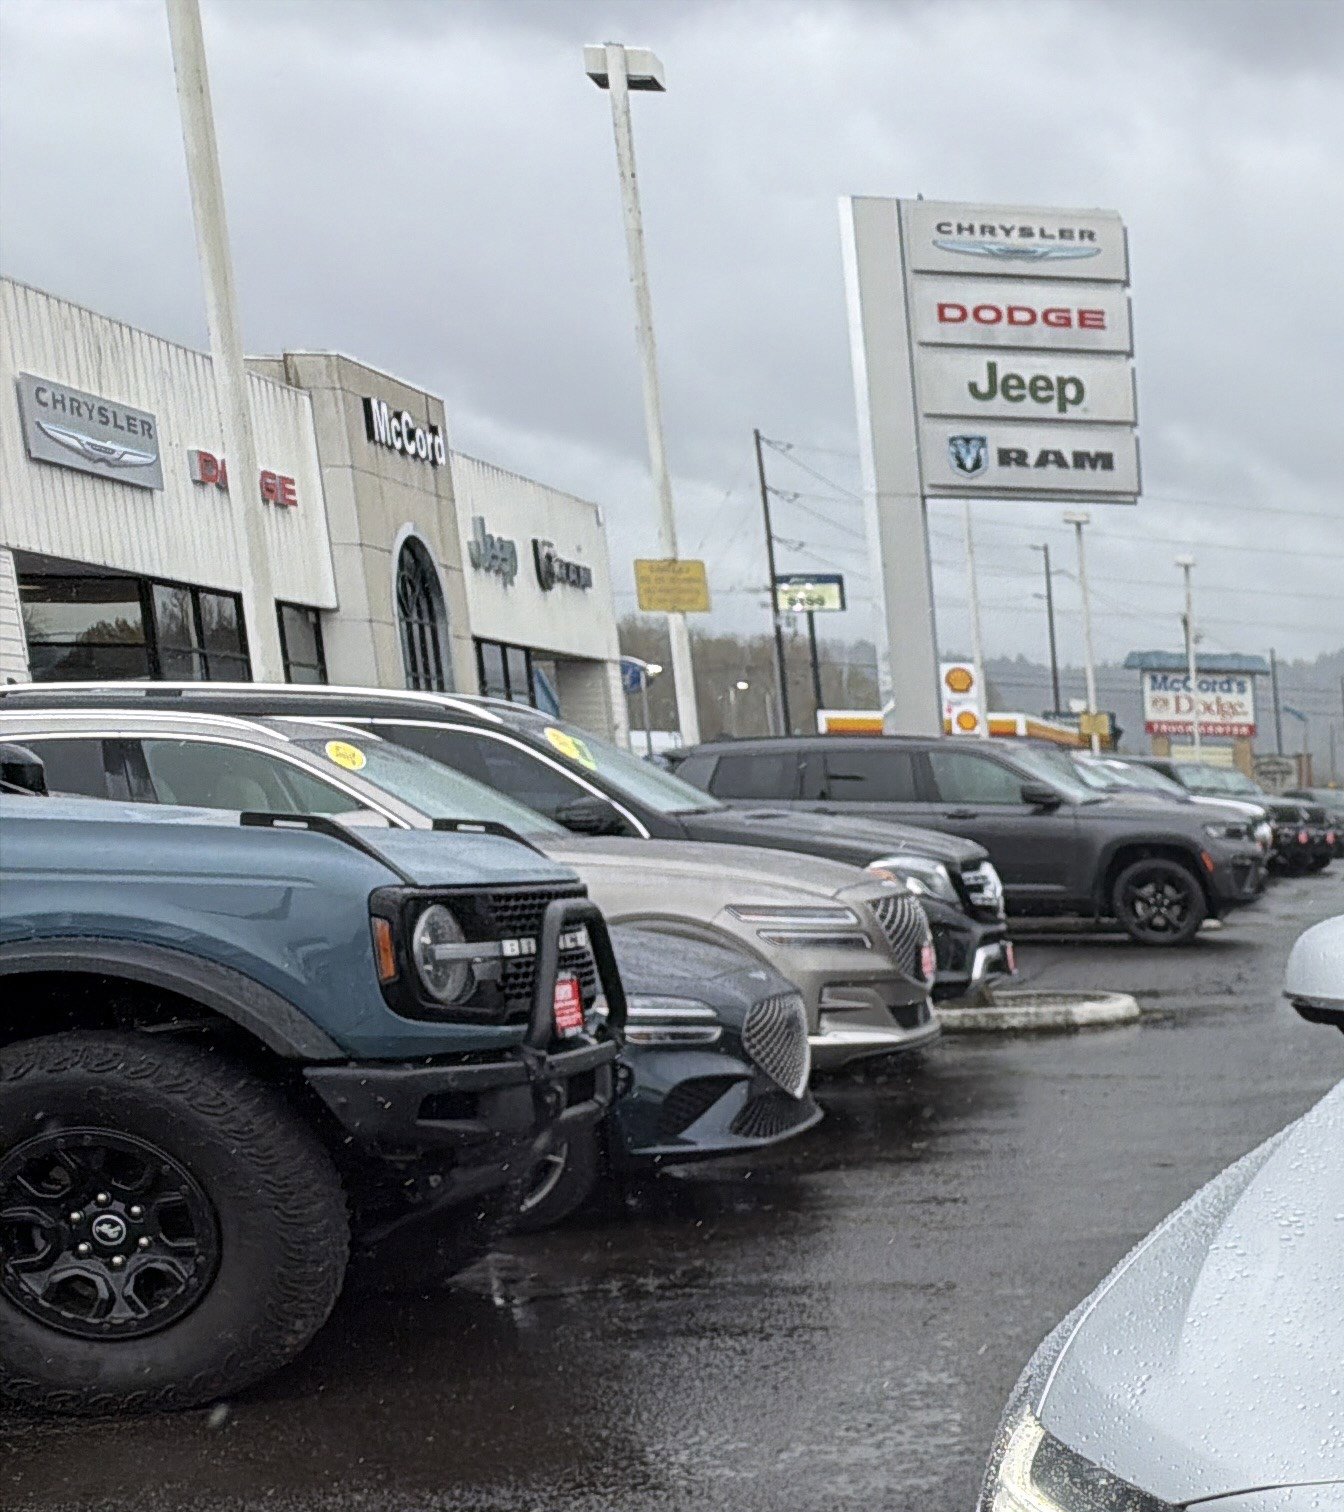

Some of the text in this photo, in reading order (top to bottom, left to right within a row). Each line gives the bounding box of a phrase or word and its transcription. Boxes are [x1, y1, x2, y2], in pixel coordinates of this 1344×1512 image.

[936, 221, 1096, 242] CHRYSLER
[936, 302, 1107, 330] DODGE
[34, 386, 154, 440] CHRYSLER
[968, 361, 1085, 413] Jeep
[369, 397, 446, 466] McCord
[196, 449, 299, 507] DGE
[997, 447, 1115, 471] RAM
